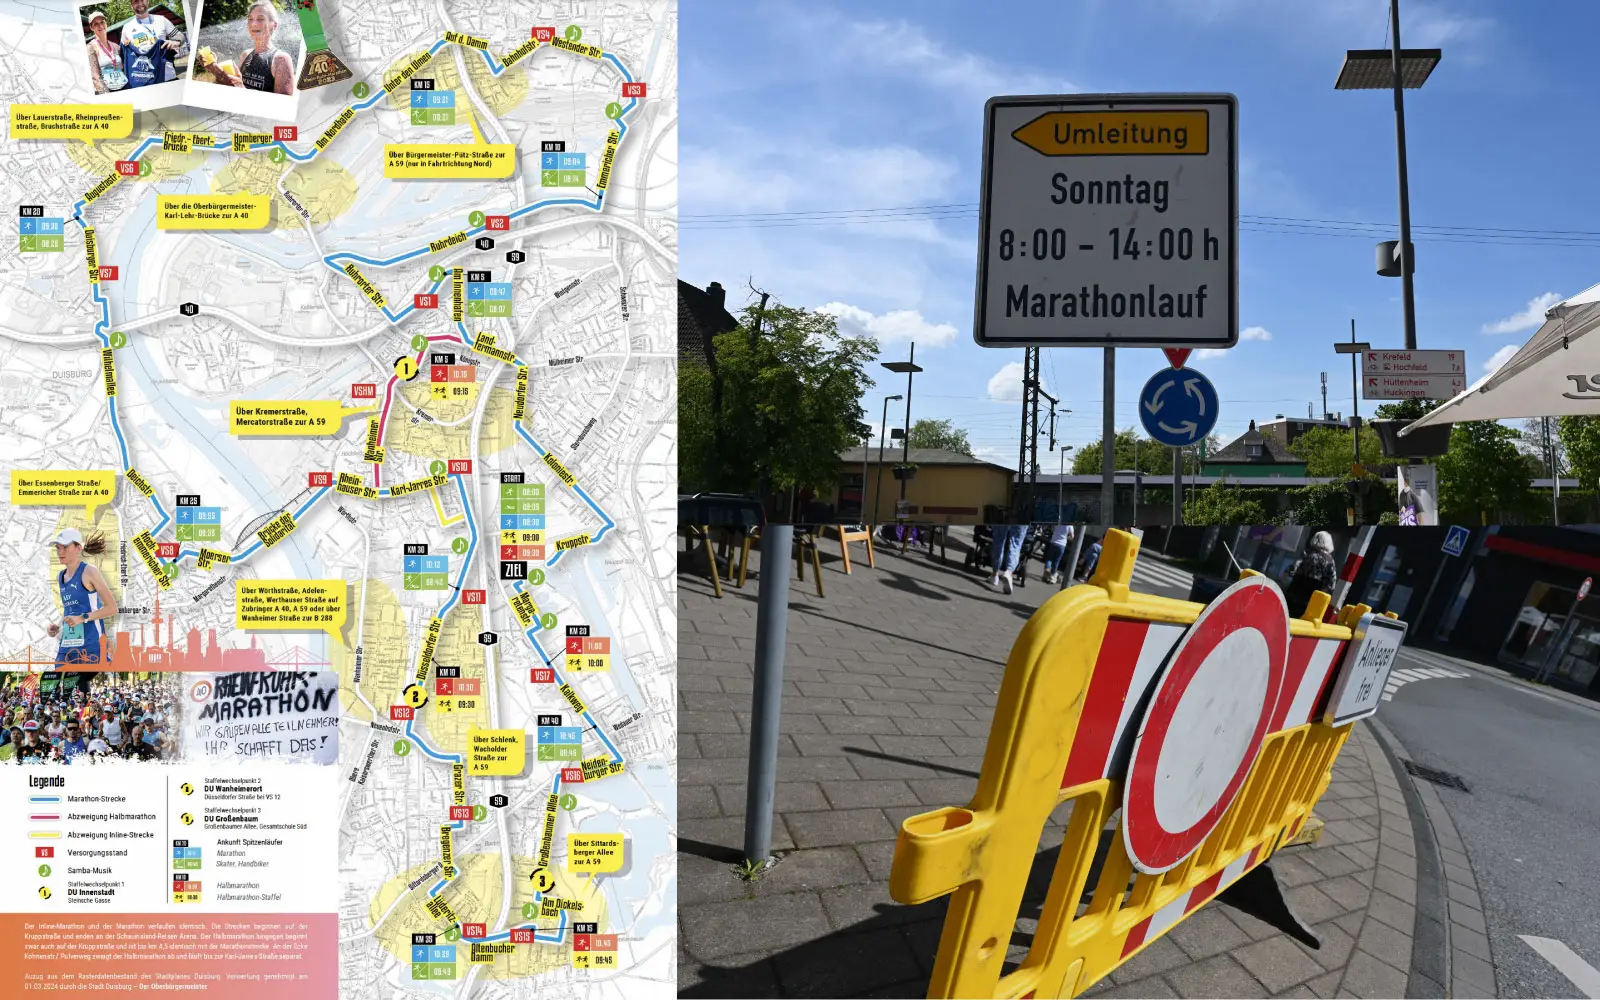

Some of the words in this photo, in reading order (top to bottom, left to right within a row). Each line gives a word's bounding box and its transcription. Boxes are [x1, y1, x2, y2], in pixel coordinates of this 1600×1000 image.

[536, 30, 549, 39] VS4
[502, 41, 540, 67] Bahnhofstr.
[551, 37, 587, 55] Westender
[588, 48, 602, 58] Str.
[384, 75, 403, 93] Unter
[401, 66, 413, 80] den
[411, 52, 432, 73] Ulmen
[628, 85, 641, 94] VS3
[33, 113, 74, 122] Lauerstraße,
[76, 113, 123, 122] Rheinpreußen-
[278, 129, 292, 138] VS5
[317, 138, 329, 150] Am
[326, 108, 354, 140] Nordhafen
[1054, 123, 1187, 149] Umleitung
[234, 133, 273, 144] Homberger
[234, 143, 247, 151] Str.
[407, 151, 492, 160] Bürgermeister-Pütz-Straße
[596, 148, 617, 189] Emmericher
[608, 131, 620, 147] Str.
[120, 164, 134, 173] VS6
[406, 160, 418, 168] (nur
[428, 160, 471, 169] Fahrtrichtung
[472, 160, 492, 168] Nord)
[84, 172, 121, 202] Augustastr.
[1051, 173, 1169, 212] Sonntag
[491, 218, 504, 228] VS2
[84, 229, 96, 270] Duisburger
[431, 232, 467, 253] Ruhrdeich
[480, 239, 488, 248] 40
[1000, 228, 1066, 260] 8:00
[1110, 228, 1192, 260] 14:00
[1204, 228, 1218, 260] h
[511, 252, 520, 262] 59
[89, 269, 99, 283] Str.
[100, 268, 112, 278] VS7
[454, 268, 463, 278] Am
[344, 263, 378, 298] Ruhrorter
[370, 291, 383, 308] Str.
[419, 296, 431, 306] VS1
[453, 279, 463, 322] Innenhafen
[1006, 285, 1207, 317] Marathonlauf
[185, 305, 193, 313] 40
[478, 332, 496, 347] Land-
[474, 340, 515, 362] fermannstr.
[103, 349, 115, 396] Wilhelmallee
[518, 366, 528, 380] Str.
[354, 386, 373, 396] VSHM
[1384, 389, 1425, 398] Huckingen
[514, 380, 526, 419] Neudorfer
[236, 407, 253, 416] Über
[255, 408, 308, 417] Kremerstraße,
[236, 418, 293, 426] Mercatorstraße
[451, 463, 468, 472] VS10
[544, 454, 574, 487] Koloniestr.
[127, 469, 153, 498] Deichstr.
[313, 474, 327, 484] VS9
[339, 473, 362, 486] Rhein-
[390, 479, 432, 496] Karl-Jarres
[433, 475, 448, 486] Str.
[337, 483, 363, 496] hauser
[364, 488, 377, 499] Str.
[556, 535, 591, 551] Kruppstr.
[160, 546, 174, 555] VS8
[200, 548, 230, 563] Moerser
[198, 558, 211, 570] Str.
[506, 564, 523, 577] ZIEL
[466, 592, 481, 602] VS11
[520, 591, 535, 615] Marga-
[484, 634, 492, 643] 59
[417, 632, 438, 681] Düsseldorfer
[430, 618, 442, 633] Str.
[1358, 638, 1394, 673] Anlieger
[535, 671, 550, 681] VS17
[1355, 676, 1376, 703] frei
[199, 688, 336, 723] MARATHON
[560, 684, 583, 713] Kalkweg
[394, 708, 410, 718] VS12
[195, 725, 211, 738] WIR
[252, 723, 271, 736] ALLE
[474, 735, 489, 743] Über
[235, 741, 282, 756] SCHAFFT
[581, 758, 608, 771] Neiden-
[584, 765, 606, 780] burger
[608, 763, 624, 775] Str.
[30, 775, 64, 789] Legende
[454, 765, 463, 790] Grazer
[565, 770, 580, 780] VS16
[455, 790, 464, 805] Str.
[453, 809, 469, 818] VS13
[538, 812, 556, 867] Großenbaumer
[549, 794, 559, 812] Allee
[441, 826, 452, 865] Bregenzer
[574, 849, 592, 858] berger
[445, 865, 454, 880] Str.
[466, 926, 482, 936] VS14
[514, 931, 530, 941] VS15
[471, 953, 493, 962] Damm
